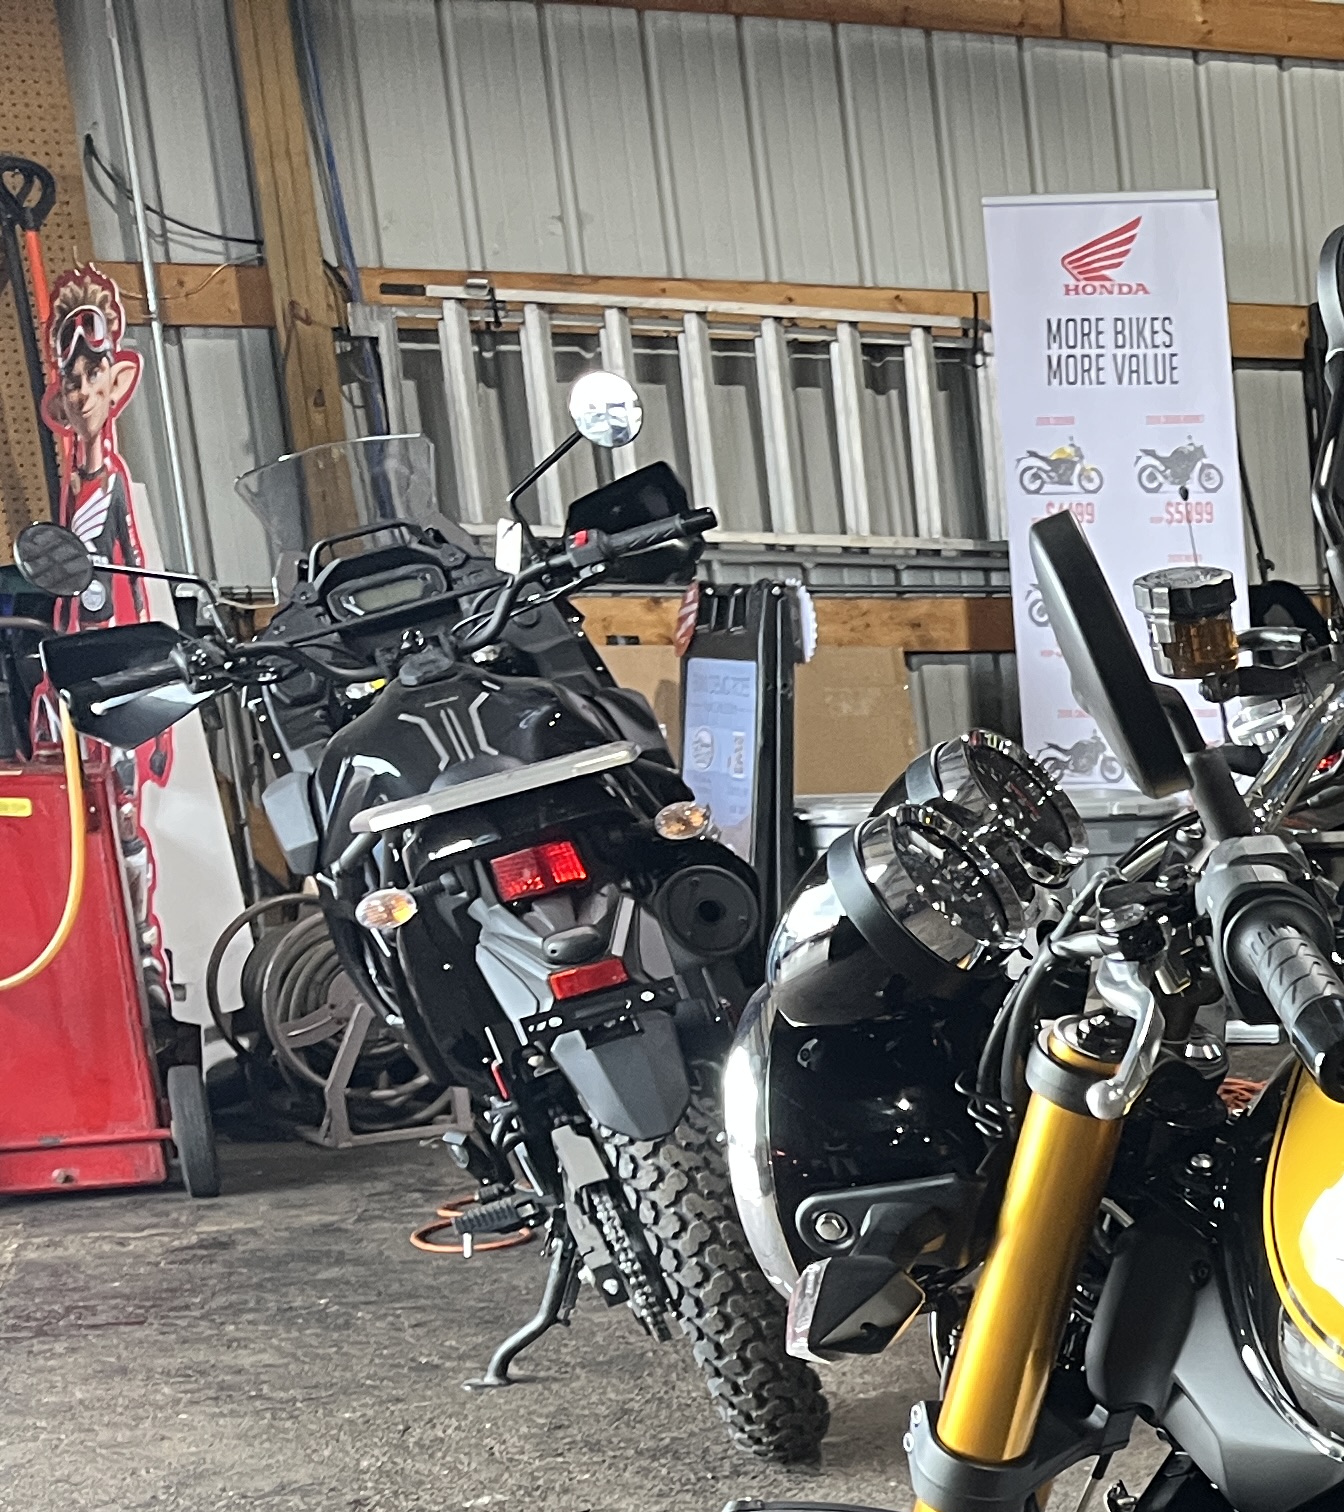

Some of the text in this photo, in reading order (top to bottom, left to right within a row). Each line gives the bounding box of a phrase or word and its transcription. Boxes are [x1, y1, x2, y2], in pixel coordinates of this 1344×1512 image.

[1063, 283, 1150, 296] HONDA
[1046, 316, 1174, 351] MORE BIKES
[1046, 352, 1180, 387] MORE VALUE
